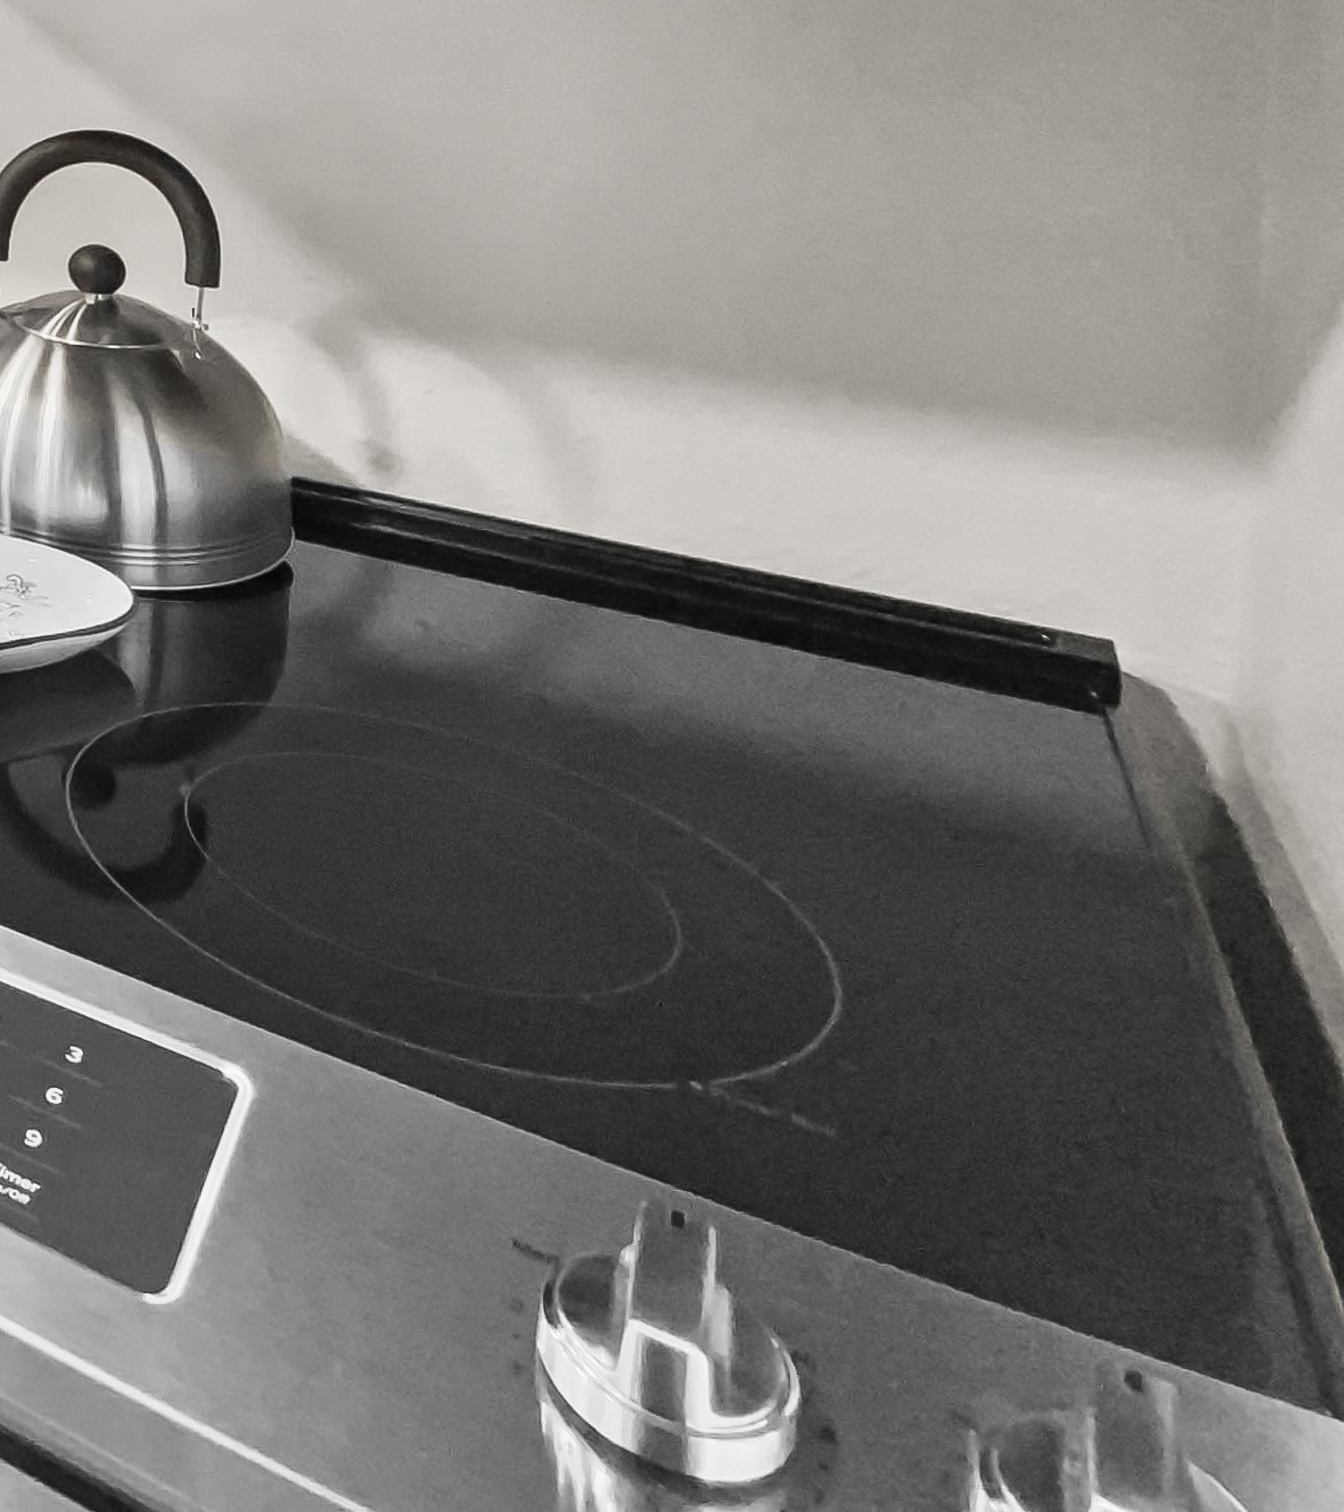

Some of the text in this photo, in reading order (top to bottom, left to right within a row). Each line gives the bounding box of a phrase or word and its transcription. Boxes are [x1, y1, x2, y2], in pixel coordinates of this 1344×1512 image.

[64, 1045, 85, 1064] 3
[44, 1086, 64, 1105] 6
[23, 1128, 43, 1148] 9
